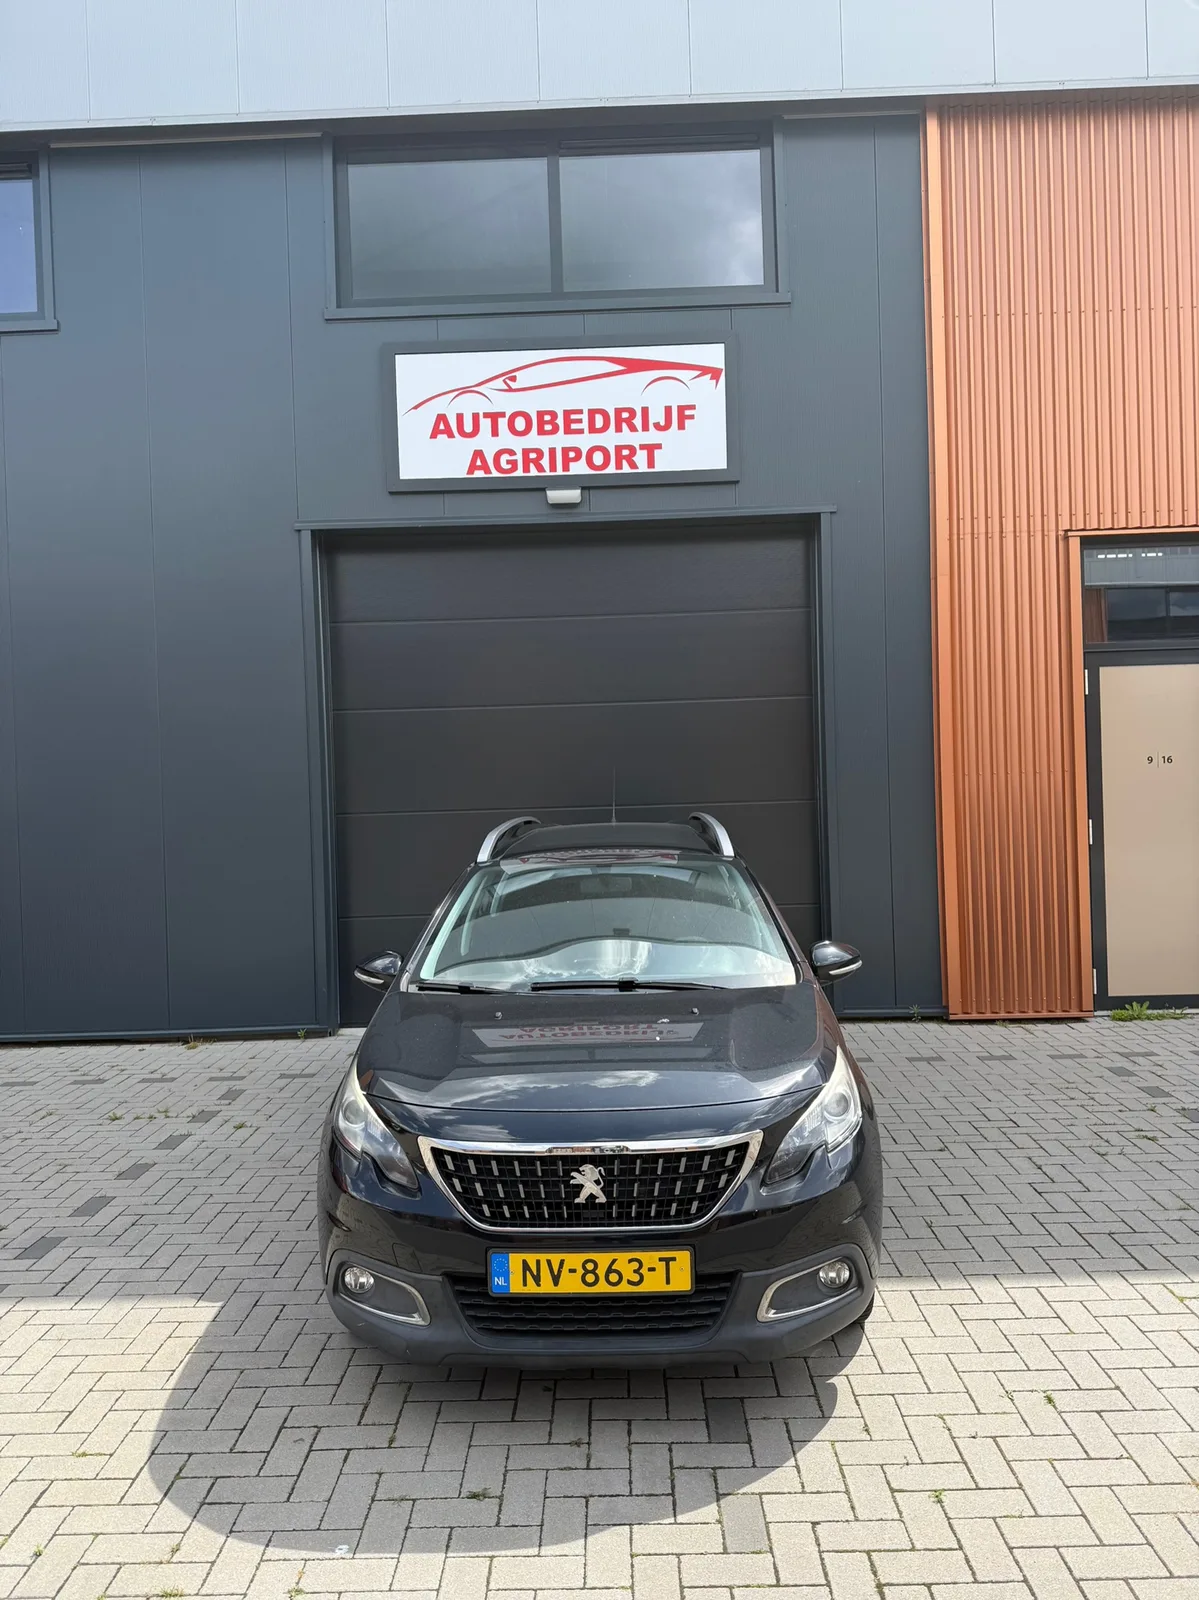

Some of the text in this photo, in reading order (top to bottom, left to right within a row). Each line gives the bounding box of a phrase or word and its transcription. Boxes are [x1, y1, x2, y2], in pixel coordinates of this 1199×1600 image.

[429, 404, 697, 439] AUTOBEDRIJF
[466, 443, 663, 475] AGRIPORT
[1161, 755, 1173, 764] 16
[494, 1277, 507, 1286] NL
[522, 1256, 677, 1287] NV-863-T
